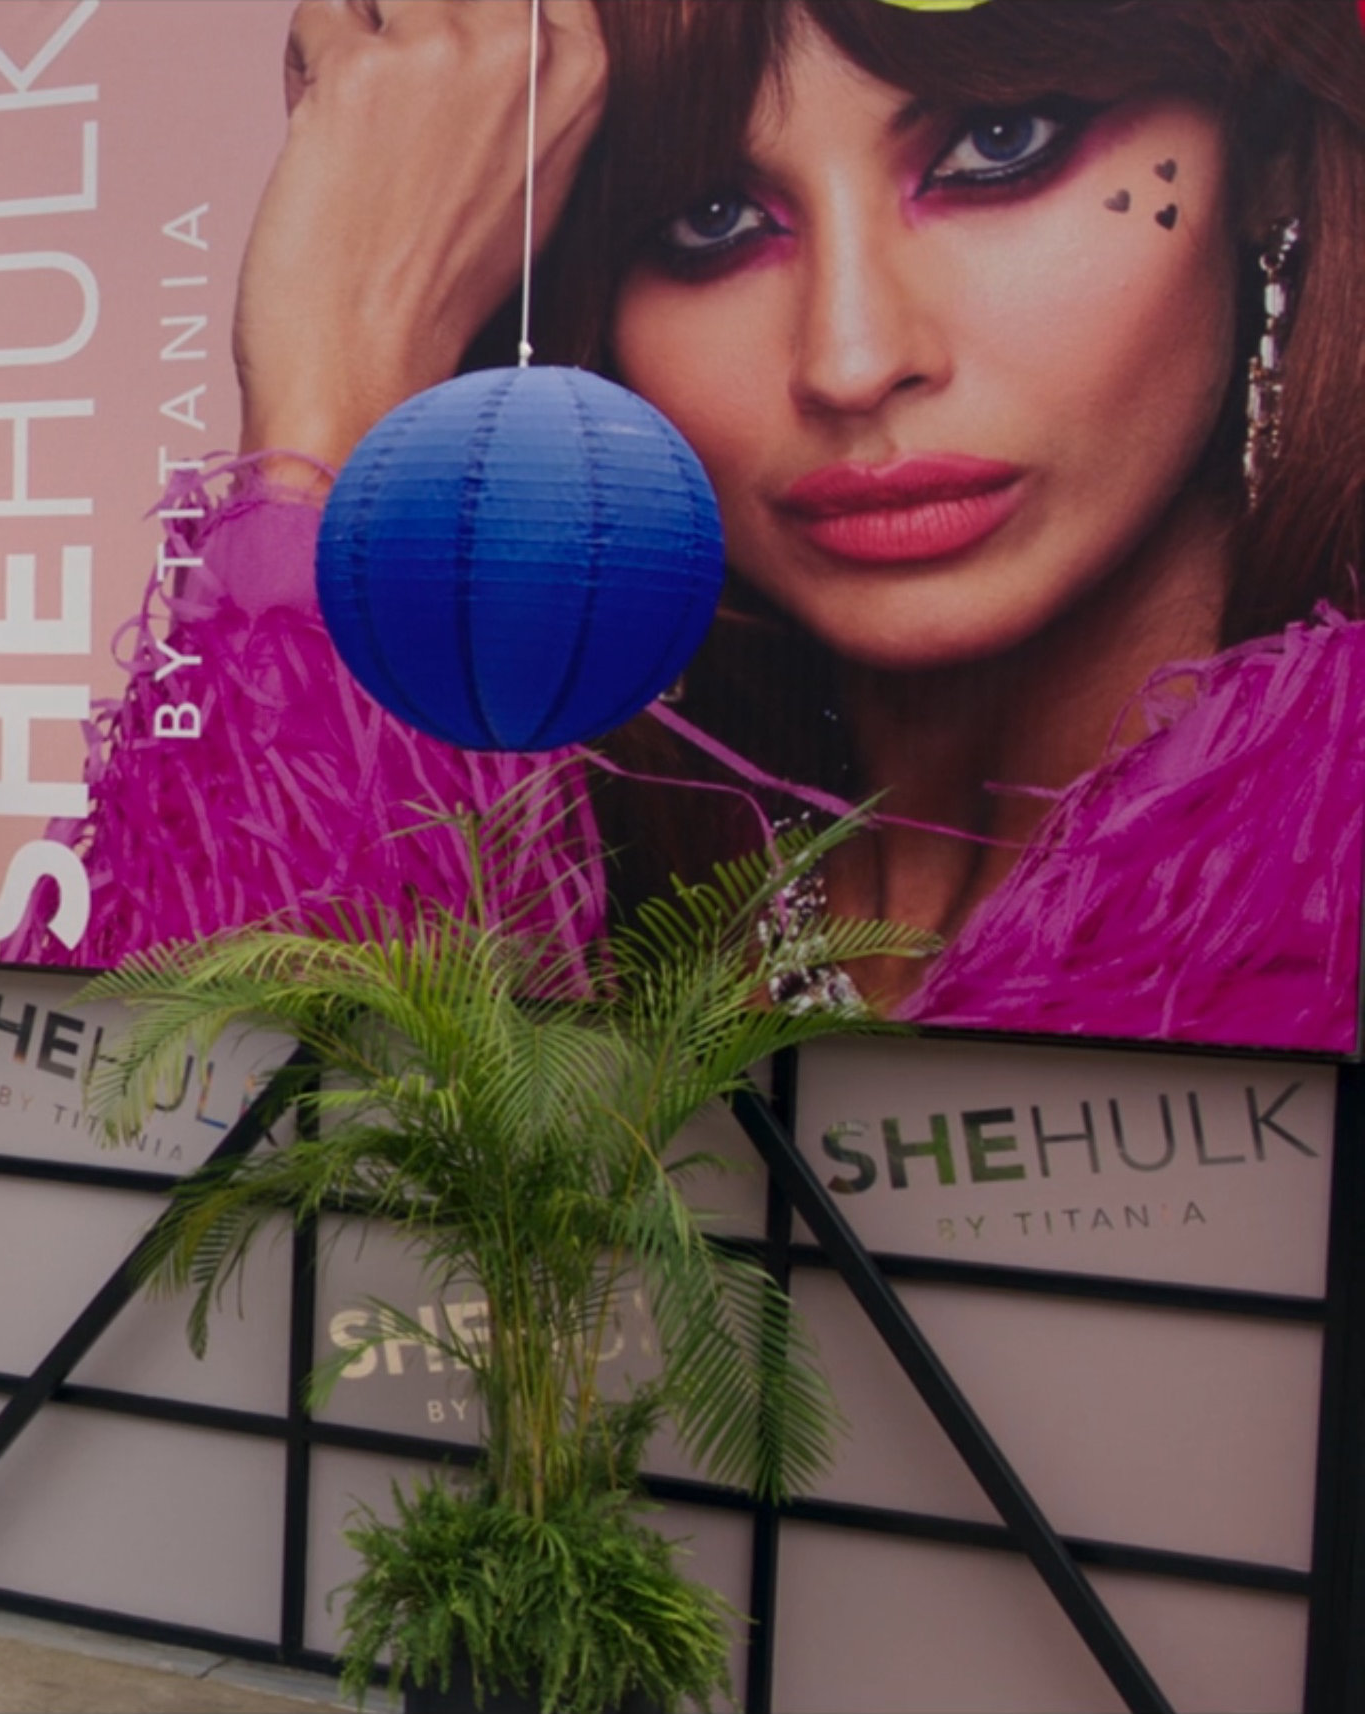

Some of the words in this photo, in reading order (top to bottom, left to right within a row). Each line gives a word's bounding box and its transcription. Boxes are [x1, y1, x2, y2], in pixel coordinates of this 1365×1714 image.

[157, 203, 210, 579] TITANIA
[153, 638, 203, 740] BY
[820, 1080, 1320, 1196] SHEHULK
[937, 1216, 986, 1241] BY
[426, 1400, 469, 1424] BY
